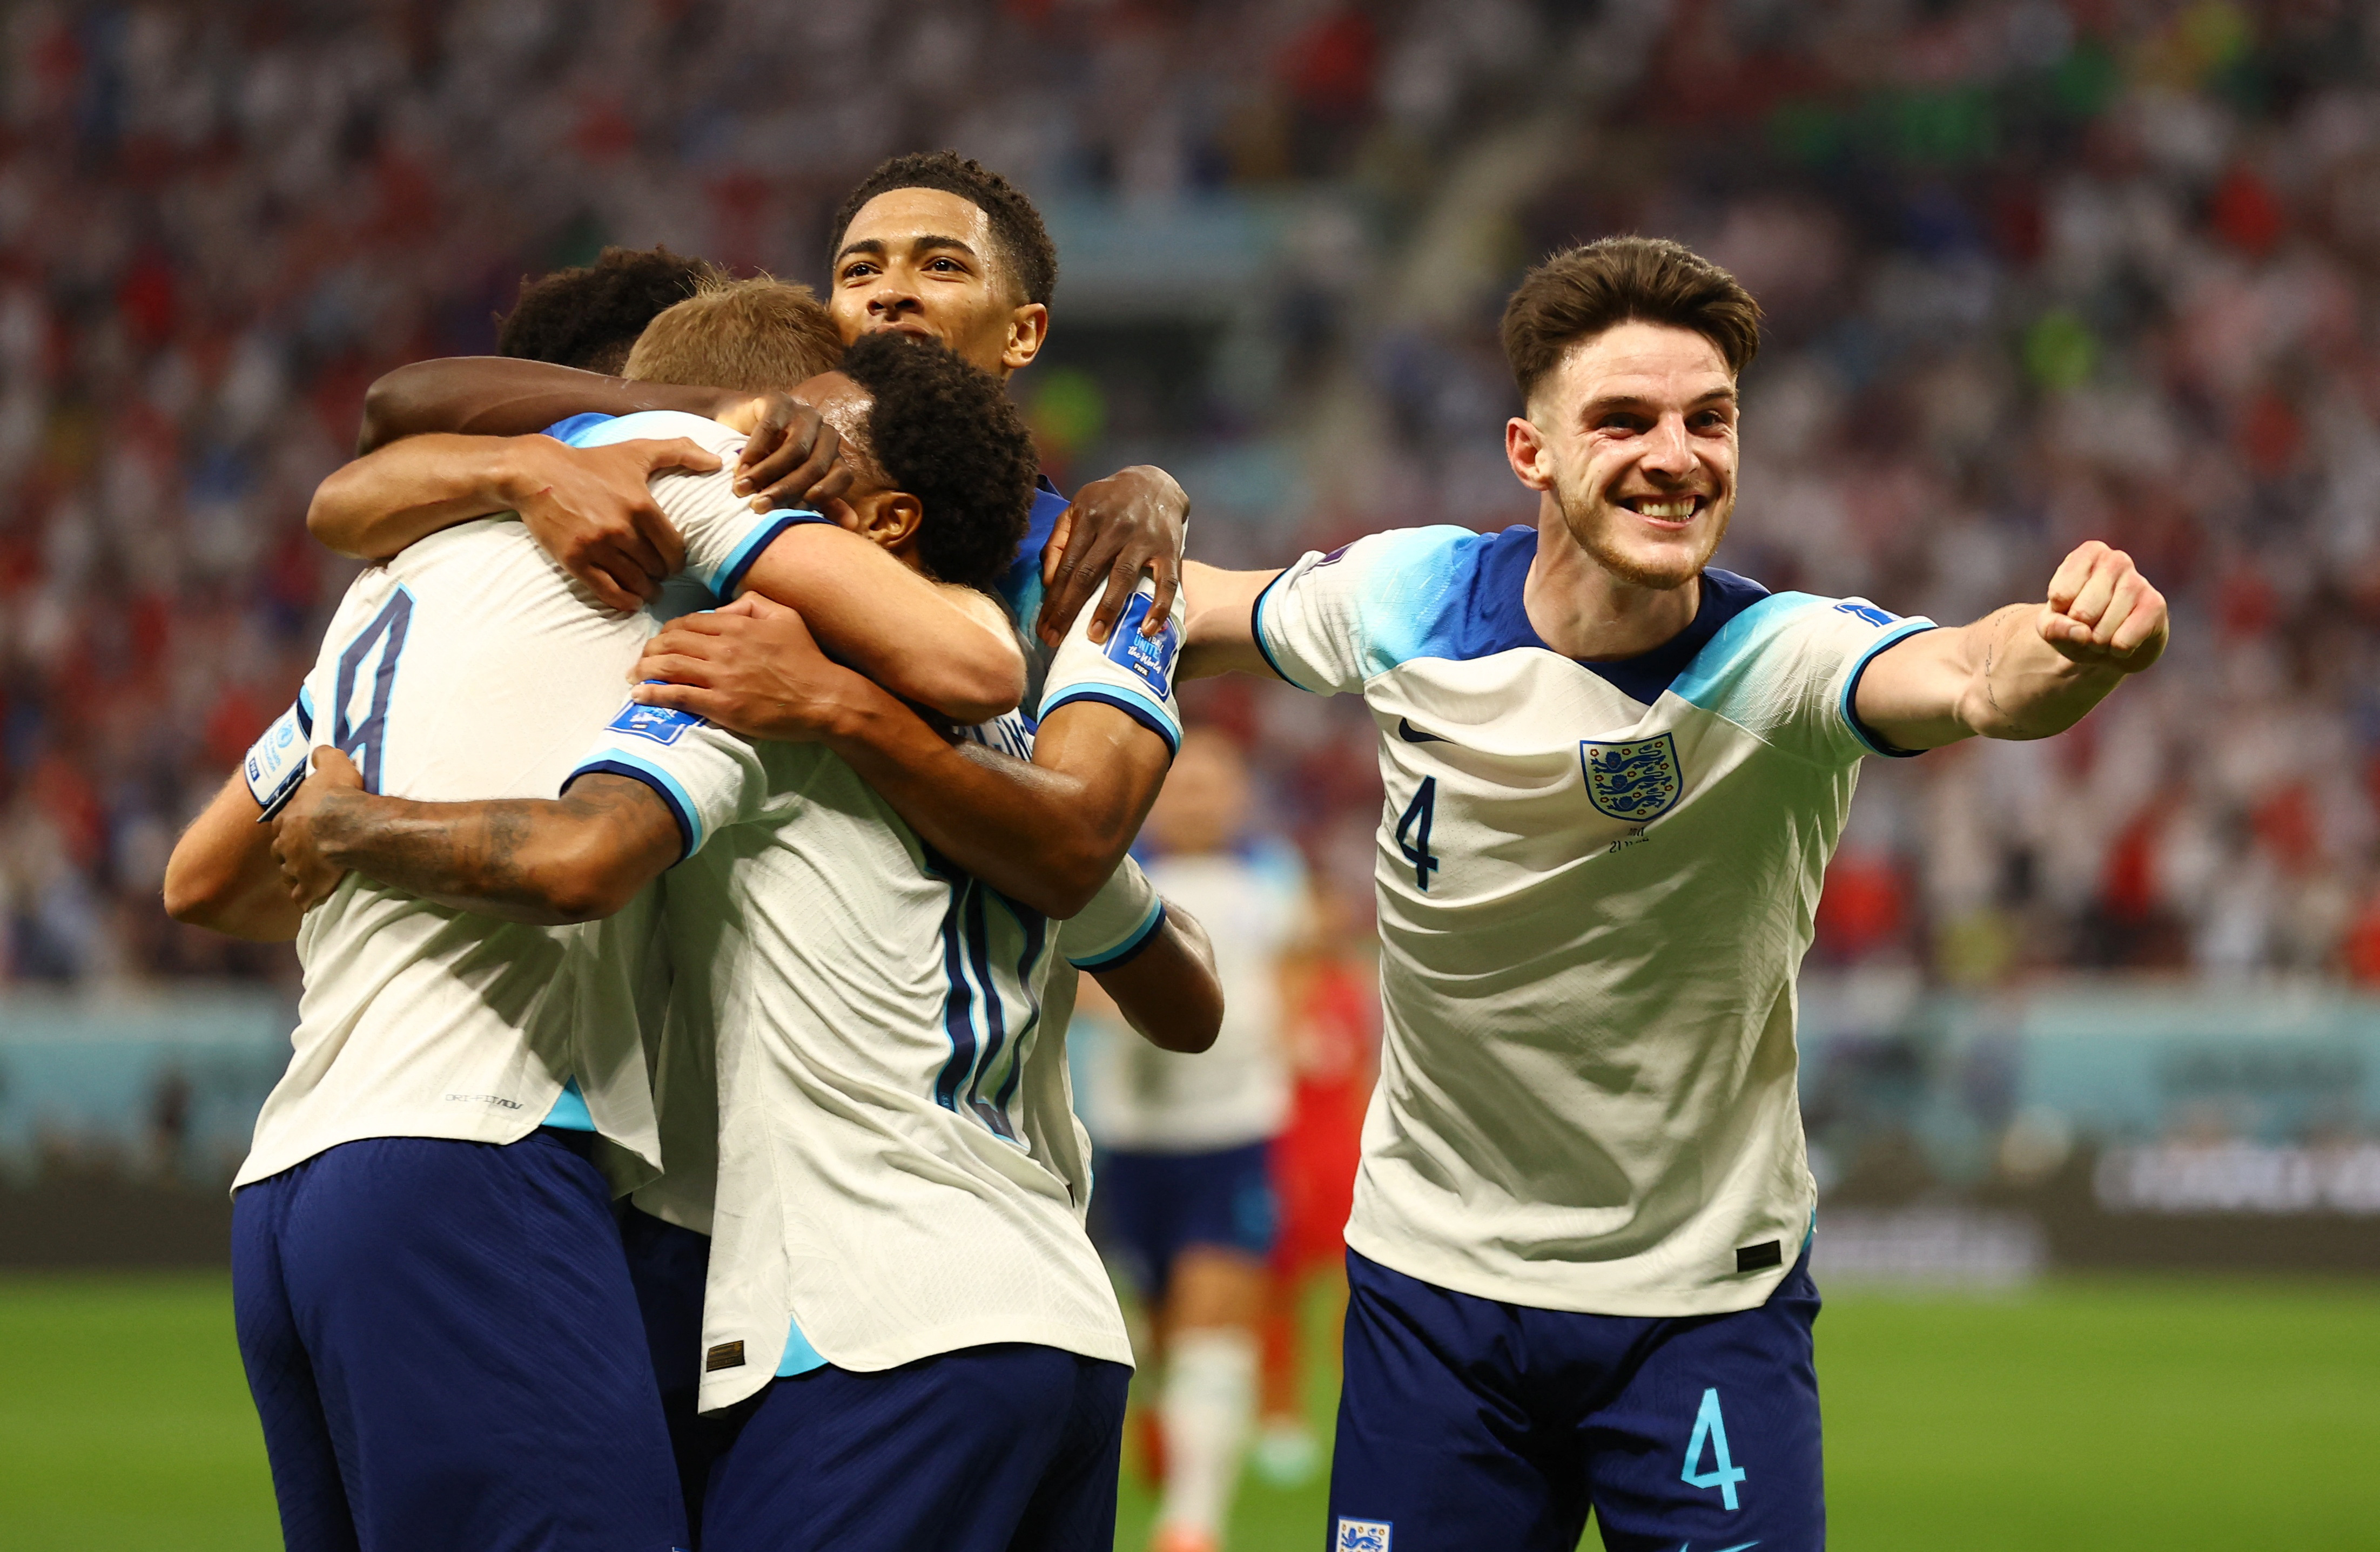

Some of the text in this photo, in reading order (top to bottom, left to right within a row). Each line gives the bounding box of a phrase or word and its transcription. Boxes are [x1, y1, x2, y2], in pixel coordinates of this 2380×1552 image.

[333, 581, 418, 796] 9
[1128, 646, 1141, 658] the
[1134, 663, 1149, 676] FIFA
[1396, 774, 1438, 892] 4
[922, 837, 1047, 1150] 10
[1680, 1387, 1747, 1511] 4
